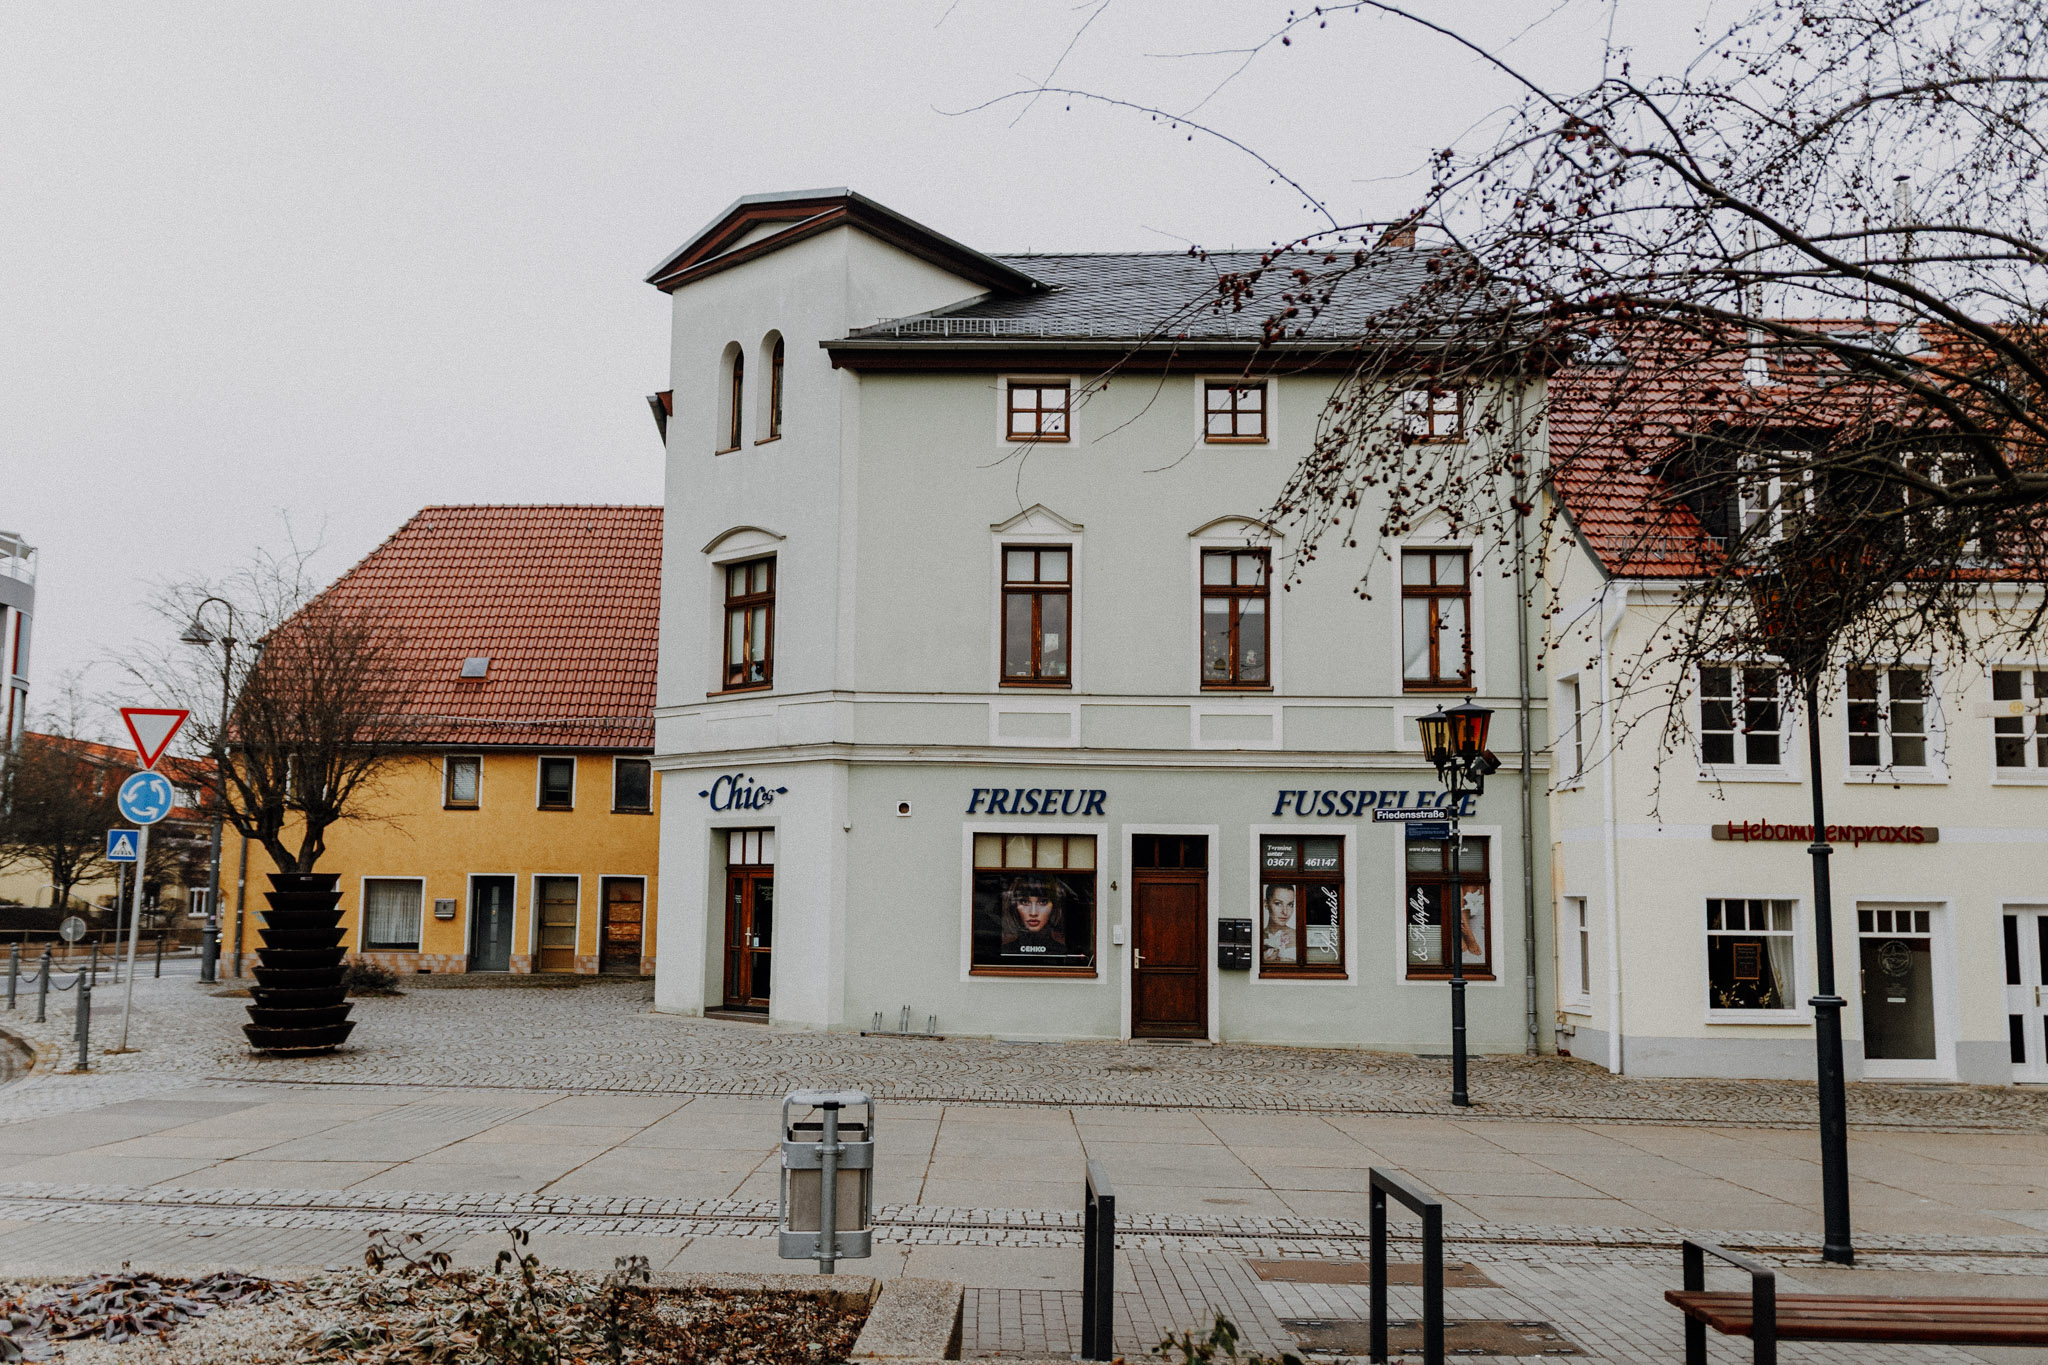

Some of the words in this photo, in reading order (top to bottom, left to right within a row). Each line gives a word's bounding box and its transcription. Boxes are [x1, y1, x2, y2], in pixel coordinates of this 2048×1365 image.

[710, 773, 766, 811] Chic
[965, 788, 1107, 816] FRISEUR
[1376, 809, 1445, 820] Friedensstraße
[1267, 858, 1295, 867] 03671
[1305, 858, 1337, 867] 461147
[1110, 880, 1118, 892] 4
[1320, 886, 1338, 960] Kosmetik
[1412, 946, 1428, 961] &
